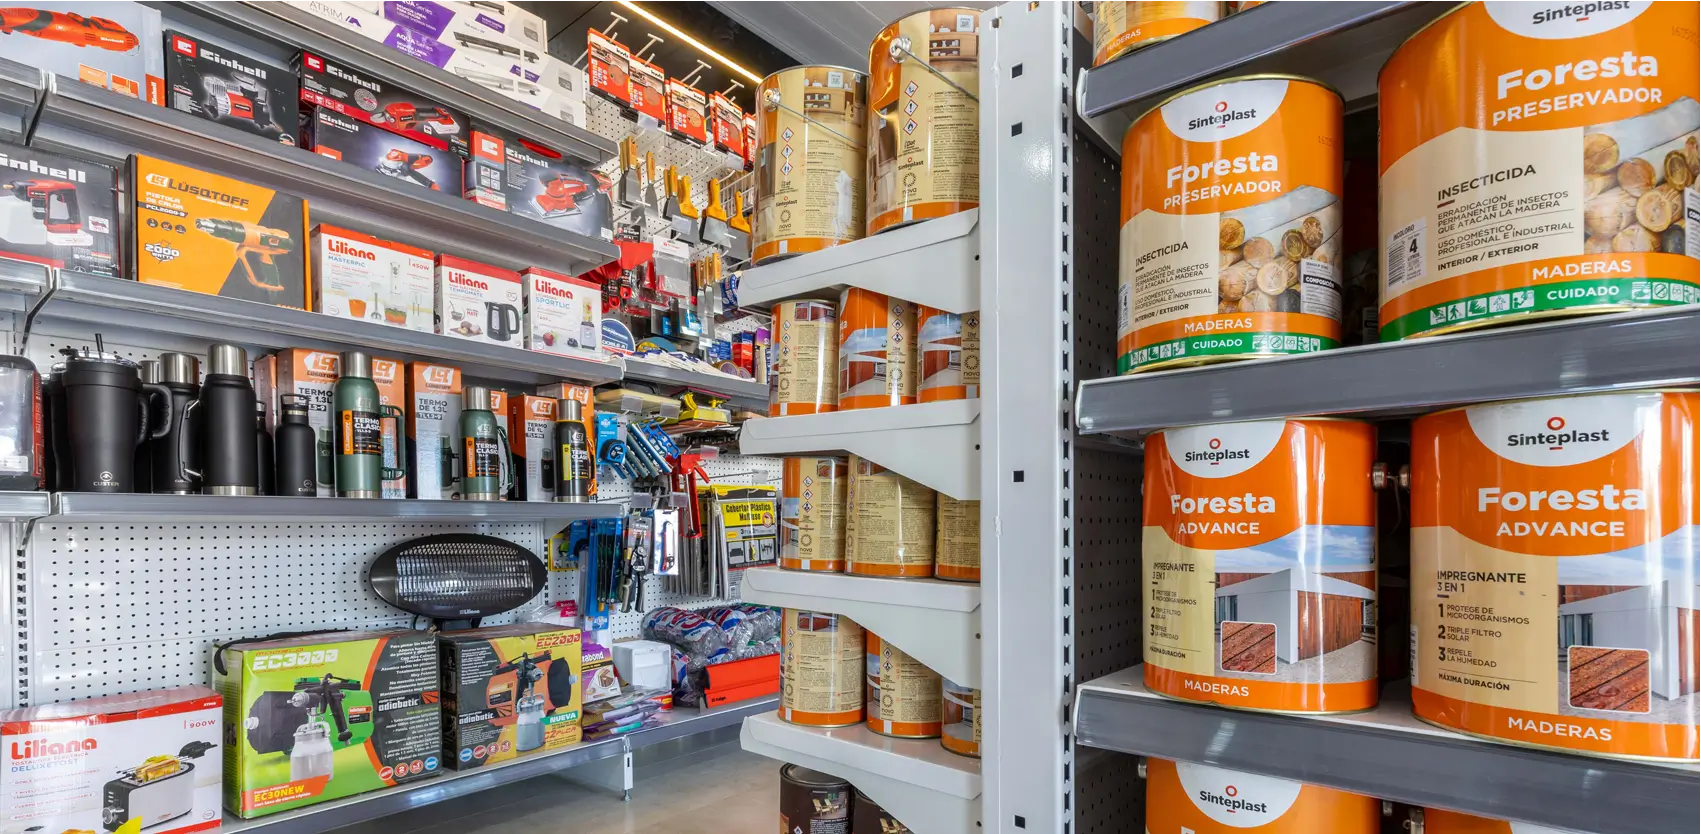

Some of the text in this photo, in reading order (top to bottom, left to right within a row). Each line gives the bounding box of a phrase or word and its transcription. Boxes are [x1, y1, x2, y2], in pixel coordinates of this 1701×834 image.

[310, 0, 343, 20] ATRIM
[1532, 0, 1631, 25] Sinteplast
[200, 48, 267, 80] Einhell
[326, 64, 381, 93] Einhell
[1497, 51, 1659, 100] Foresta
[1493, 87, 1663, 127] PRESERVADOR
[319, 112, 359, 132] Einhell
[1188, 108, 1257, 131] Sinteplast
[505, 147, 549, 168] Einhell
[0, 153, 86, 184] inhell
[1167, 151, 1278, 189] Foresta
[1437, 164, 1537, 202] INSECTICIDA
[1164, 180, 1281, 210] PRESERVADOR
[1438, 193, 1508, 221] ERRADICACIÓN
[1438, 189, 1570, 229] PERMANENTE DE INSECTOS
[1438, 199, 1561, 235] QUE ATACAN LA MADERA
[1409, 237, 1419, 254] 4
[1438, 221, 1576, 257] PROFESIONAL E INDUSTRIAL
[1438, 238, 1457, 251] USO
[145, 243, 181, 258] 2000
[328, 238, 377, 262] Liliana
[1135, 240, 1190, 268] INSECTICIDA
[1437, 254, 1479, 272] INTERIOR
[1488, 242, 1540, 259] EXTERIOR
[328, 255, 367, 268] MASTERPIC
[1176, 262, 1209, 275] INSECTOS
[1533, 260, 1632, 281] MADERAS
[448, 271, 489, 291] Liliana
[1144, 278, 1165, 290] ATACAN
[1175, 270, 1204, 281] MADERA
[535, 279, 574, 300] Liliana
[1173, 287, 1212, 300] INDUSTRIAL
[1547, 285, 1620, 301] CUIDADO
[535, 296, 571, 311] SPORTLIC
[1159, 302, 1189, 316] EXTERIOR
[1184, 317, 1253, 334] MADERAS
[1192, 338, 1243, 350] CUIDADO
[299, 387, 333, 397] TERMO
[419, 398, 448, 407] TERMO
[354, 416, 379, 426] TERMO
[1507, 429, 1610, 447] Sinteplast
[1185, 448, 1250, 463] Sinteplast
[1171, 492, 1276, 515] Foresta
[1478, 484, 1649, 513] Foresta
[1178, 522, 1260, 535] ADVANCE
[1496, 521, 1625, 537] ADVANCE
[1153, 562, 1195, 573] IMPREGNANTE
[1437, 570, 1527, 584] IMPREGNANTE
[1437, 582, 1466, 593] 3 EN 1
[1150, 606, 1156, 619] 2
[1437, 603, 1494, 618] 1 PROTEGE DE
[1447, 612, 1530, 625] MICROORGANISMOS
[1149, 624, 1155, 637] 3
[1437, 625, 1502, 640] 2 TRIPLE FILTRO
[1447, 633, 1470, 643] SOLAR
[536, 633, 581, 649] EC2000
[252, 649, 339, 671] EC3000
[582, 650, 605, 664] rabond
[1437, 646, 1472, 662] 3 REPELE
[1447, 655, 1497, 669] LA HUMEDAD
[1184, 679, 1250, 697] MADERAS
[1463, 679, 1510, 692] DURACIÓN
[190, 719, 216, 729] 900W
[549, 712, 576, 724] NUEVA
[1508, 716, 1613, 742] MADERAS
[11, 738, 98, 760] Liliana
[11, 759, 79, 773] DELUXETOST
[254, 784, 305, 803] EC30NEW
[1200, 790, 1267, 813] Sinteplast
